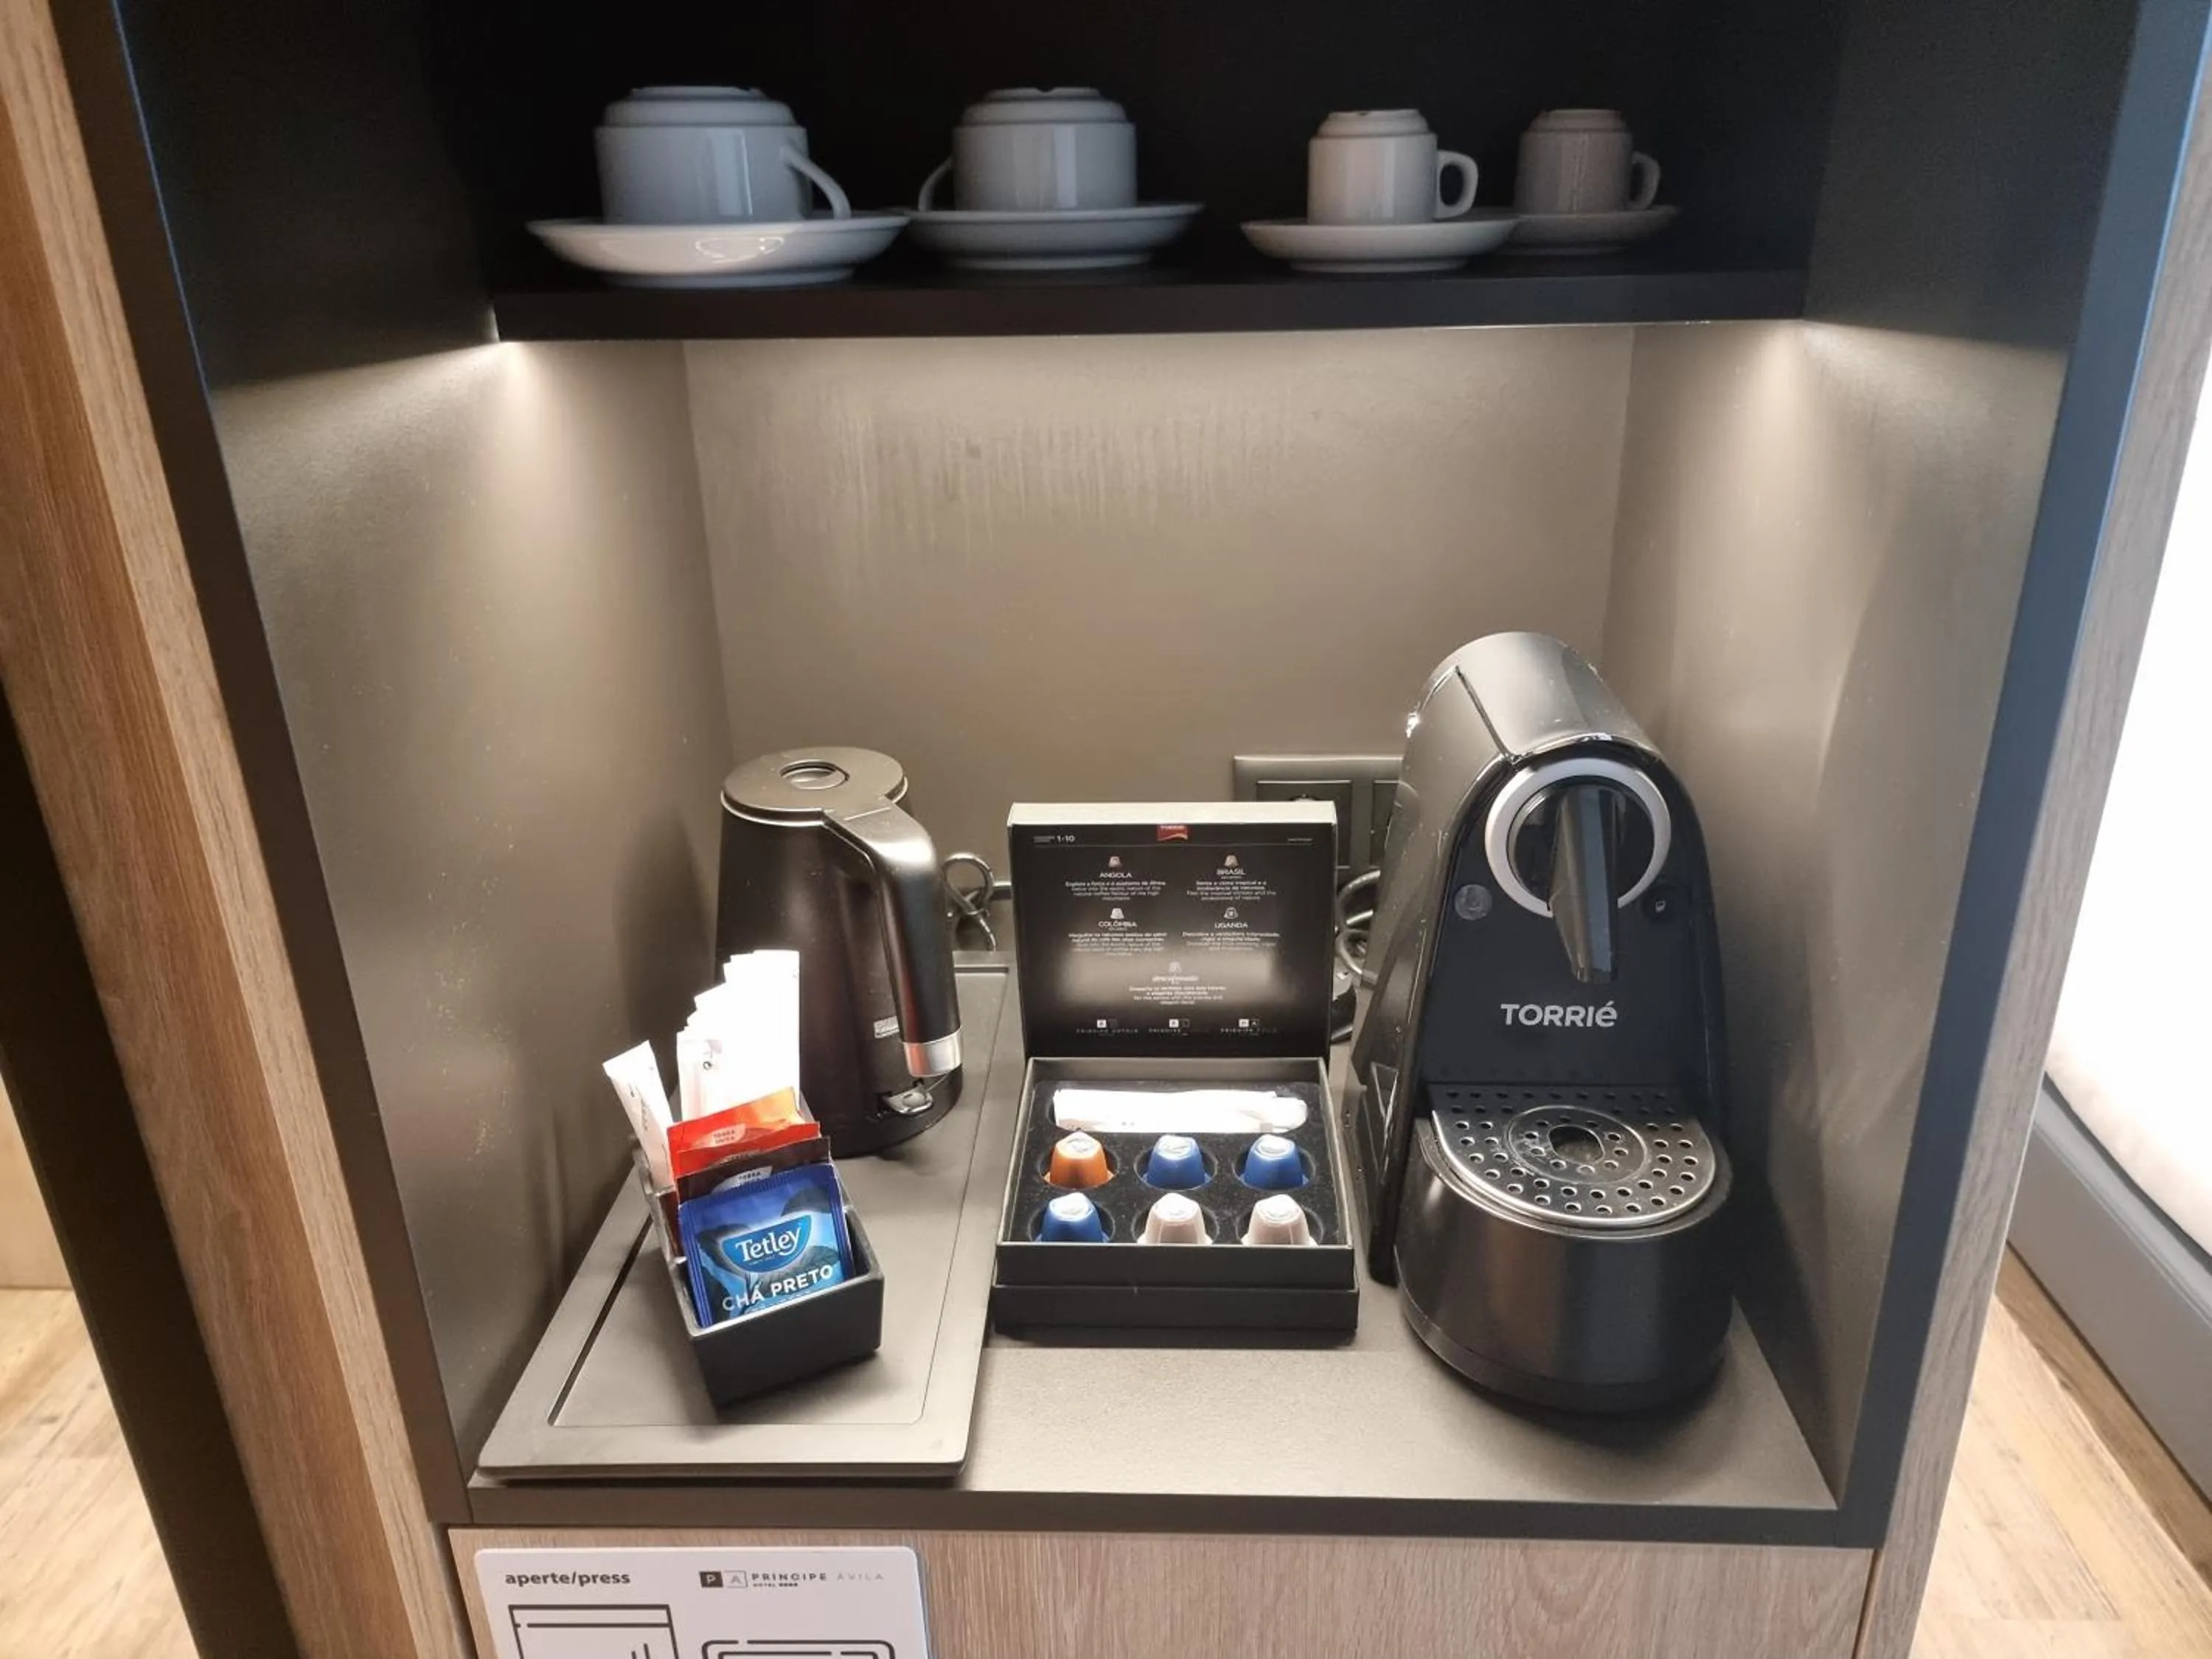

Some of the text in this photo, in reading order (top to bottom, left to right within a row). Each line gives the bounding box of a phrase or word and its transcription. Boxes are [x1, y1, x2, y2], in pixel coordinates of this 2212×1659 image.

[735, 1227, 802, 1262] Tetley
[723, 1265, 833, 1311] CHÁ PRETO
[505, 1571, 631, 1587] aperte/press
[706, 1575, 716, 1585] P
